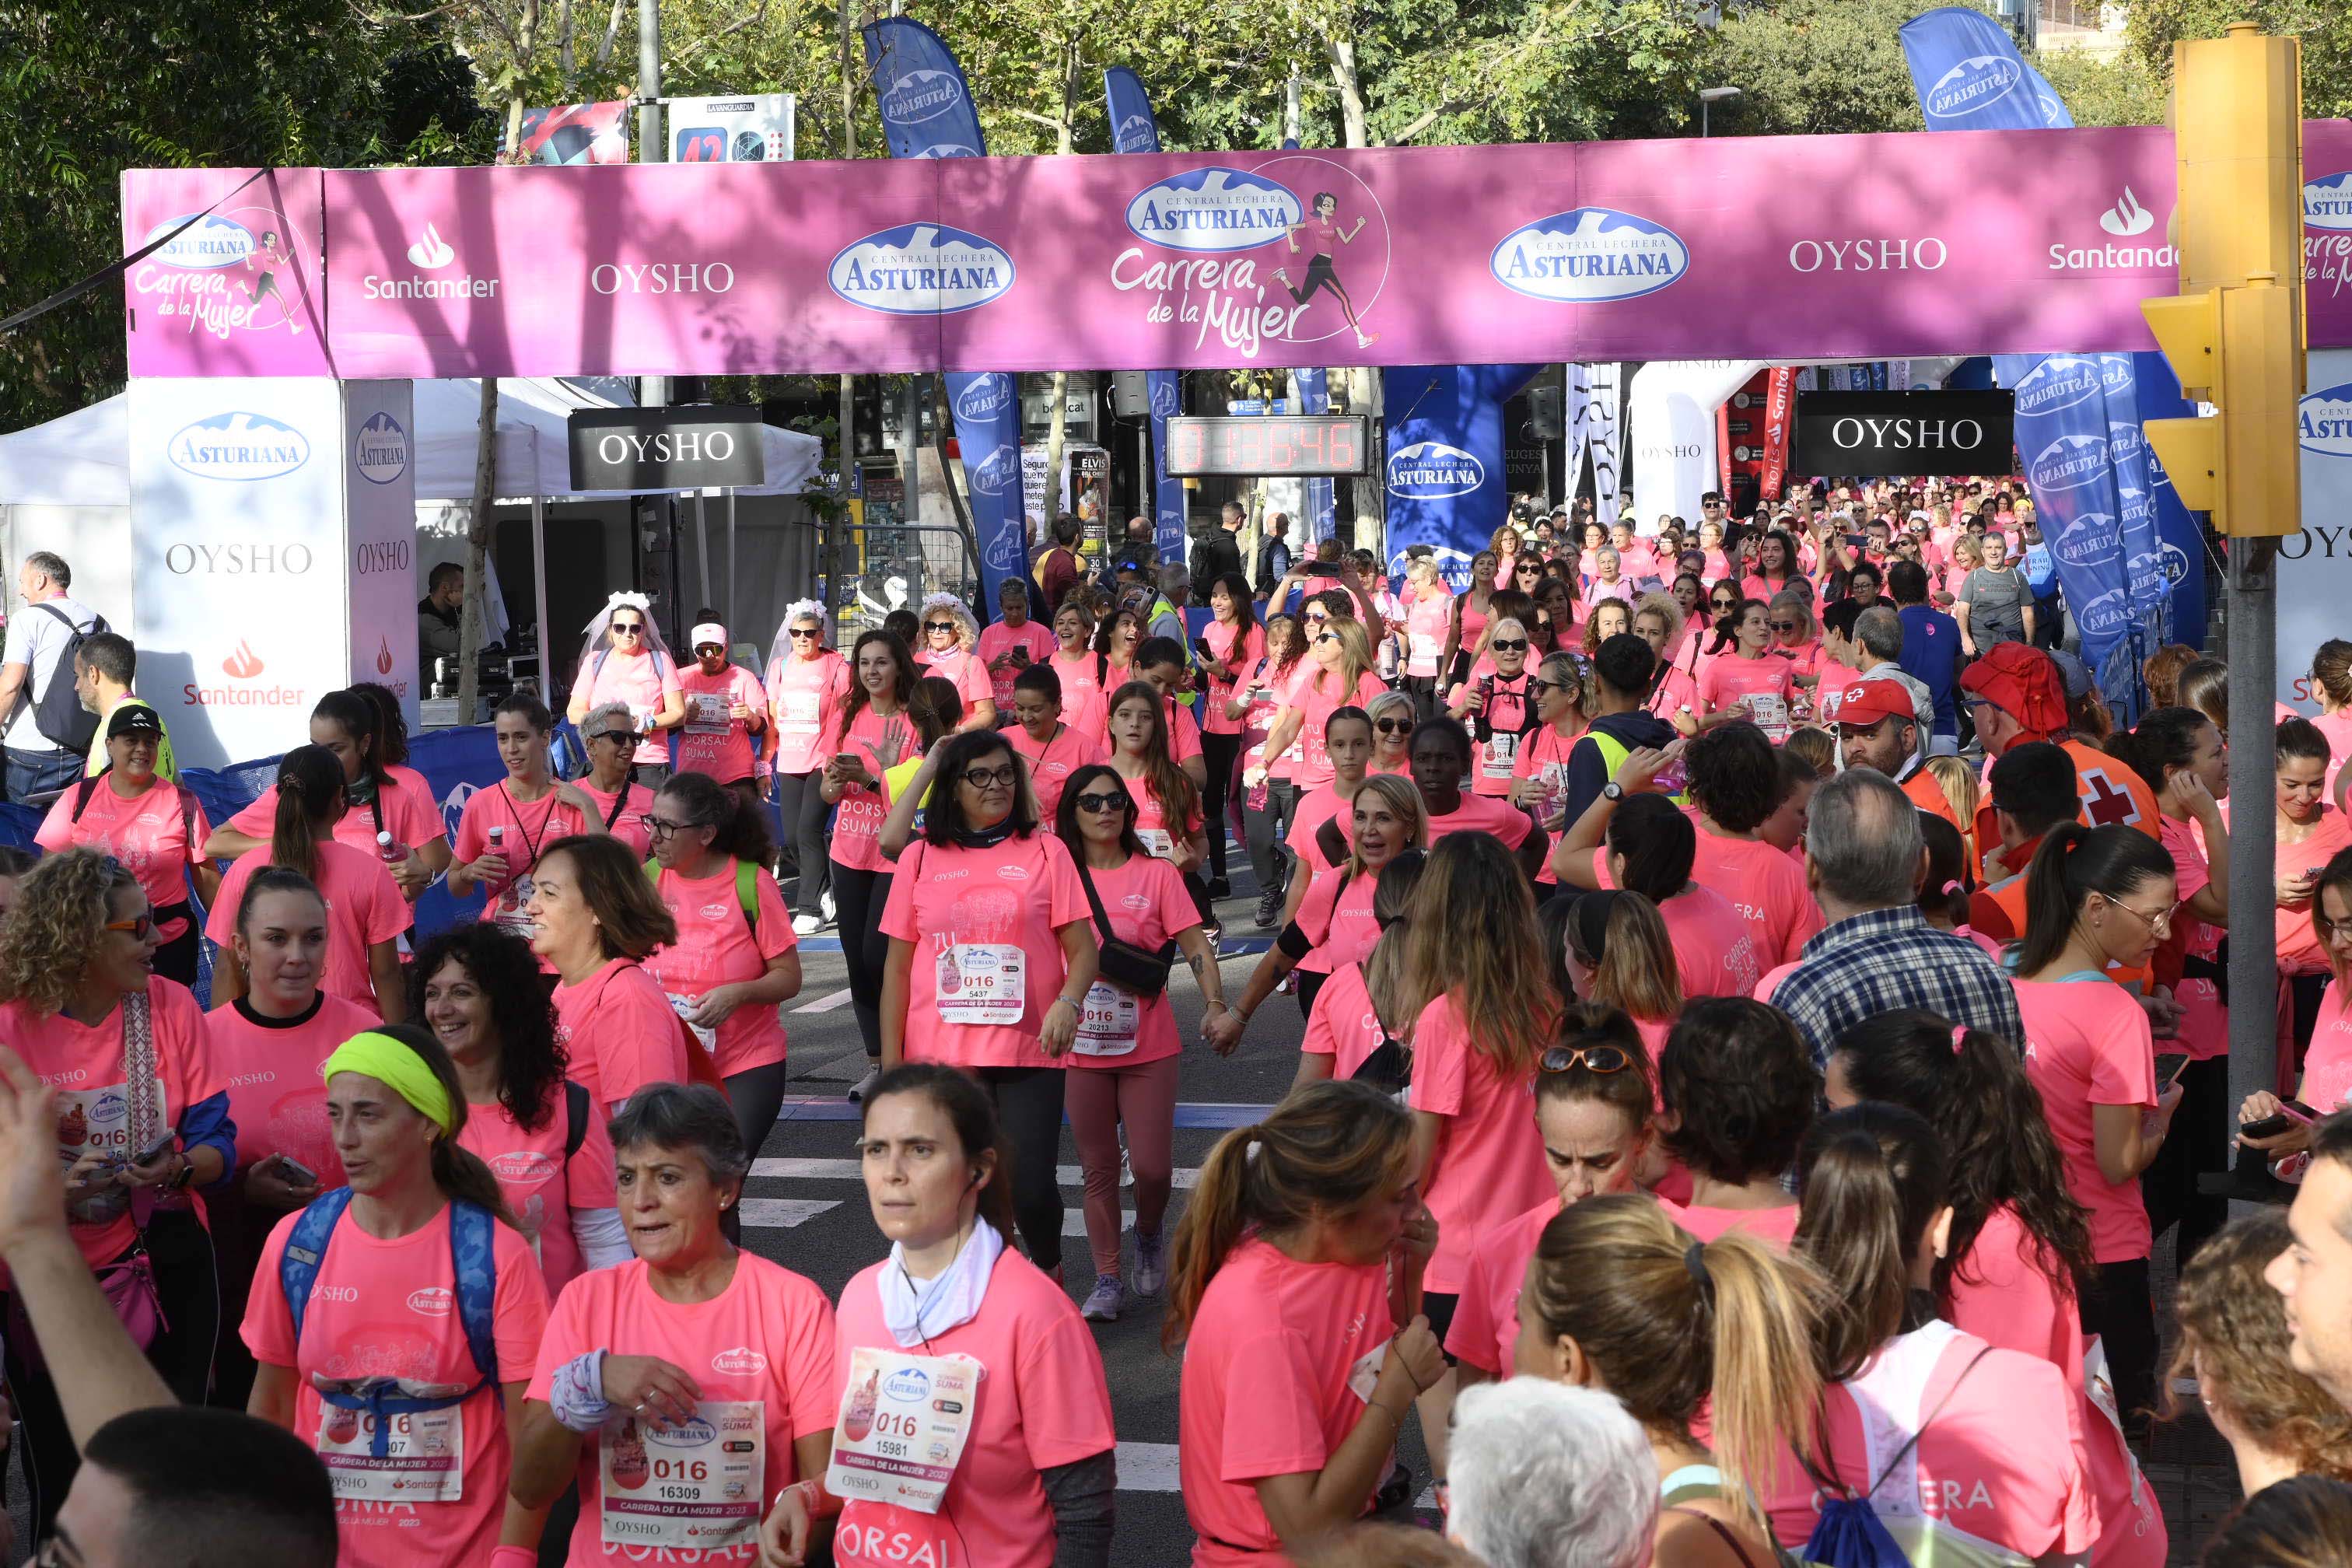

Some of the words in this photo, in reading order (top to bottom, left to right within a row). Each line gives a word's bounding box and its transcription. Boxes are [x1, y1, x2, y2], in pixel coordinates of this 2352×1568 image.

[716, 103, 754, 112] VANGUARDIA
[1166, 196, 1221, 206] CENTRAL
[1227, 195, 1283, 205] LECHERA
[1139, 199, 1290, 232] ASTURIANA
[1536, 240, 1598, 251] CENTRAL
[1605, 239, 1668, 249] LECHERA
[871, 254, 929, 264] CENTRAL
[936, 254, 995, 264] LECHERA
[1505, 245, 1674, 280] ASTURIANA
[1789, 238, 1948, 272] OYSHO
[2049, 243, 2179, 270] Santand
[843, 257, 1002, 292] ASTURIANA
[1111, 247, 1256, 292] Carrera
[2321, 257, 2336, 279] la
[135, 264, 228, 295] Carrera
[591, 262, 735, 295] OYSHO
[363, 274, 499, 300] Santander
[157, 296, 175, 316] de
[178, 293, 191, 315] la
[188, 289, 261, 339] Mujer
[1146, 293, 1174, 324] de
[1179, 292, 1199, 323] la
[1195, 285, 1312, 359] Mujer
[1772, 367, 1790, 422] Santa
[1832, 417, 1983, 450] OYSHO
[180, 437, 299, 464] ASTURIANA
[359, 436, 405, 467] ASTURIANA
[599, 431, 735, 465] OYSHO
[1642, 444, 1701, 459] OYSHO
[1081, 458, 1106, 468] ELVIS
[1389, 465, 1477, 486] ASTURIANA
[1024, 481, 1049, 490] quiere
[166, 543, 313, 575] OYSHO
[356, 539, 410, 575] OYSHO
[1090, 558, 1100, 567] 30
[183, 684, 305, 706] Santander
[1209, 686, 1232, 697] RSAL
[1209, 700, 1222, 709] MA
[1307, 723, 1320, 734] TU
[686, 736, 727, 746] DORSAL
[849, 734, 873, 743] OYSHO
[685, 747, 716, 759] SUMA
[841, 799, 887, 817] DORS
[86, 812, 116, 822] OYSHO
[934, 869, 969, 882] OYSHO
[1341, 908, 1374, 917] OYSHO
[933, 931, 956, 950] TU
[963, 957, 996, 966] ASTURIANA
[964, 976, 994, 987] 016
[1087, 1010, 1113, 1021] 016
[90, 1129, 126, 1146] 016
[936, 1381, 964, 1391] SUMA
[722, 1422, 753, 1431] SUMA
[876, 1412, 916, 1437] 016
[367, 1440, 406, 1453] 107
[876, 1440, 908, 1457] 15981
[330, 1456, 366, 1467] CARRERA
[366, 1458, 382, 1467] DE
[383, 1459, 394, 1468] LA
[396, 1459, 427, 1469] MUJER
[653, 1459, 708, 1481] 016
[845, 1455, 877, 1468] CARRERA
[877, 1459, 887, 1469] DE
[888, 1461, 898, 1471] LA
[899, 1464, 926, 1476] MUJER
[842, 1475, 880, 1490] OYSHO
[659, 1486, 701, 1500] 16309
[620, 1502, 661, 1514] CARRERA
[662, 1504, 675, 1513] DE
[676, 1505, 689, 1514] LA
[690, 1506, 723, 1515] MUJER
[726, 1506, 747, 1514] 2023
[361, 1517, 389, 1526] MUJER
[398, 1518, 421, 1528] 2023
[615, 1521, 661, 1535] OYSHO
[701, 1524, 747, 1537] Santander
